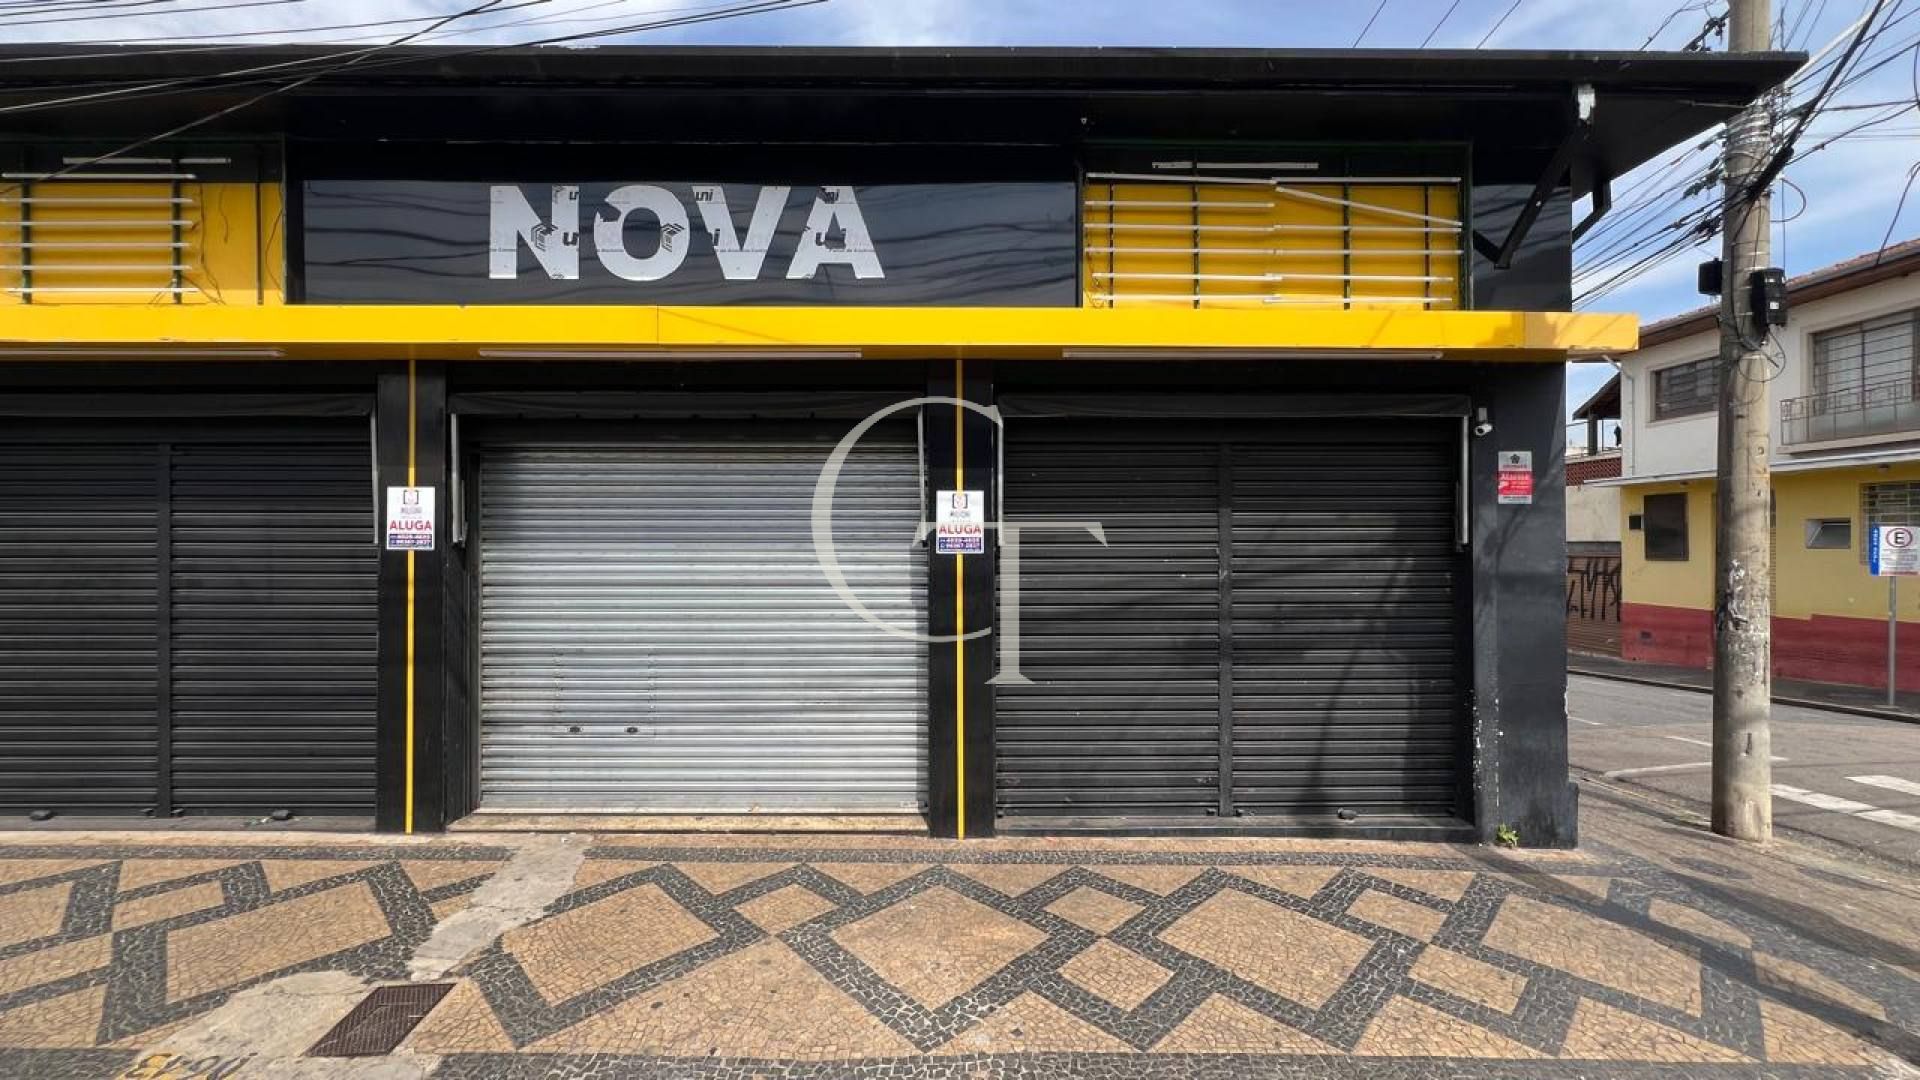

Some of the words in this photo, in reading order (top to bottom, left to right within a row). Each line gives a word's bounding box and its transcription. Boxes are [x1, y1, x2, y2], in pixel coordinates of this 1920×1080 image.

[489, 185, 885, 281] NOVA
[390, 520, 432, 530] ALUGA
[939, 524, 981, 534] ALUGA
[1894, 532, 1905, 544] E
